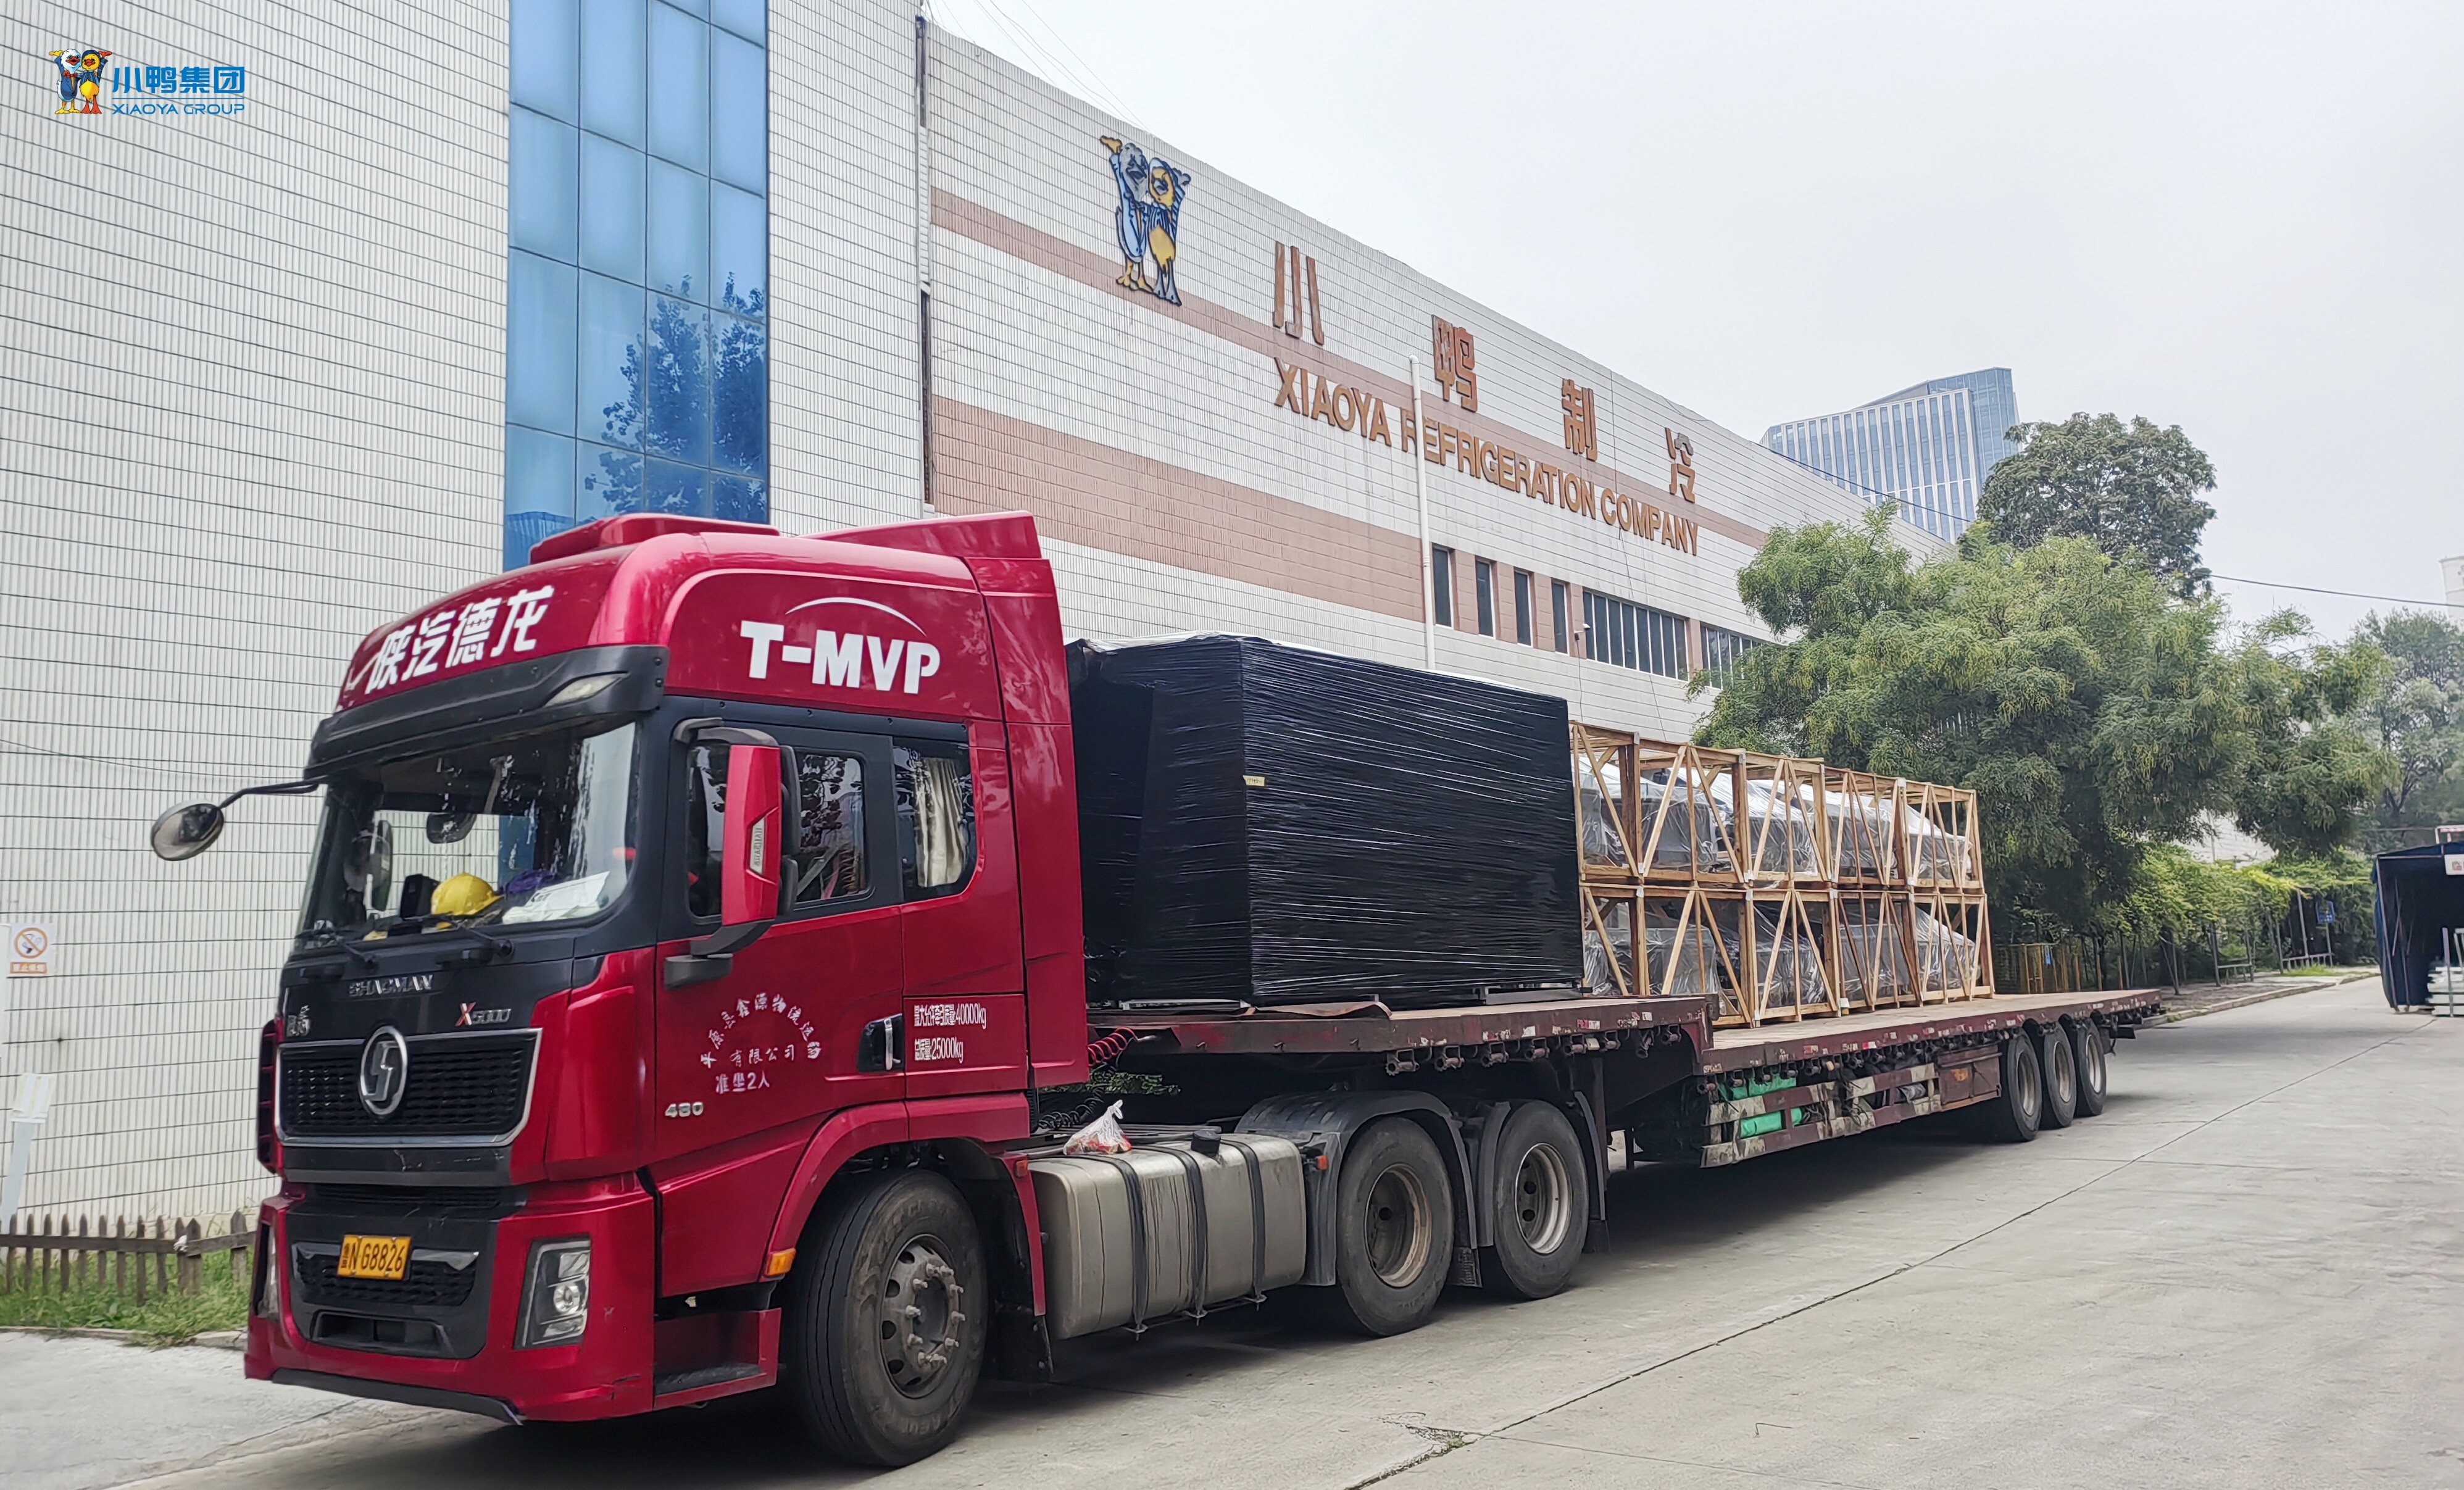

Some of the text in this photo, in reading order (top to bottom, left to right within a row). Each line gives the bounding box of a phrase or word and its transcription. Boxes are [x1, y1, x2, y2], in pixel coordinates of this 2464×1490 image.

[1274, 357, 1698, 556] XIAOYA REFRIGERATION COMPANY
[740, 620, 941, 694] T-MVP
[730, 1044, 794, 1067] 有限公司
[665, 1101, 703, 1118] 480
